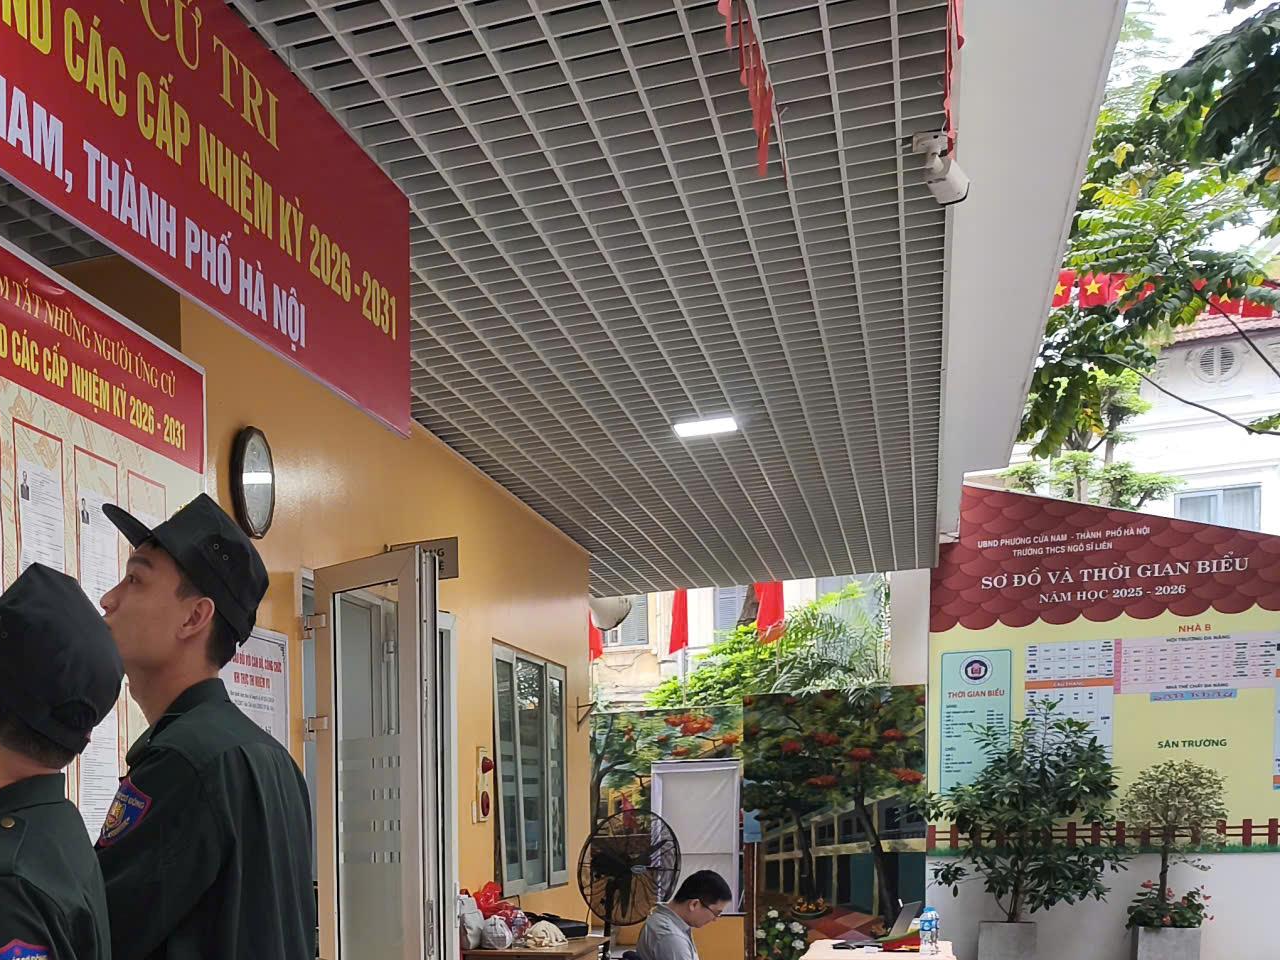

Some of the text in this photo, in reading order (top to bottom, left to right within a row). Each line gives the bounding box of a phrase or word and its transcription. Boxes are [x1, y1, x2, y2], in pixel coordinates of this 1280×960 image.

[213, 35, 279, 151] TRI
[64, 7, 127, 117] CÁC
[137, 71, 190, 165] CẤP
[199, 123, 273, 240] NHIỆM
[279, 195, 304, 263] KỲ
[309, 224, 351, 302] 2026
[362, 270, 396, 340] 2031
[83, 139, 177, 260] THÀNH
[185, 216, 232, 295] PHỐ
[239, 257, 267, 322] HÀ
[272, 283, 306, 351] NỘI
[11, 331, 39, 376] CÁC
[43, 343, 69, 390] CẤP
[71, 362, 110, 415] NHIỆM
[113, 387, 128, 421] KỲ
[129, 395, 155, 436] 2026
[163, 414, 186, 450] 2031
[14, 278, 42, 319] TẮT
[43, 298, 91, 350] NHỮNG
[93, 330, 133, 373] NGƯỜI
[135, 358, 159, 390] ỨNG
[160, 371, 177, 398] CỬ
[977, 539, 999, 548] UBND
[1050, 534, 1068, 542] NAM
[1076, 529, 1102, 540] THÀNH
[981, 551, 1249, 590] SƠ ĐỒ VÀ THỜI GIAN BIỂU
[1045, 546, 1066, 555] THCS
[1076, 589, 1109, 603] HỌC
[1112, 586, 1143, 599] 2025
[1155, 584, 1187, 596] 2026
